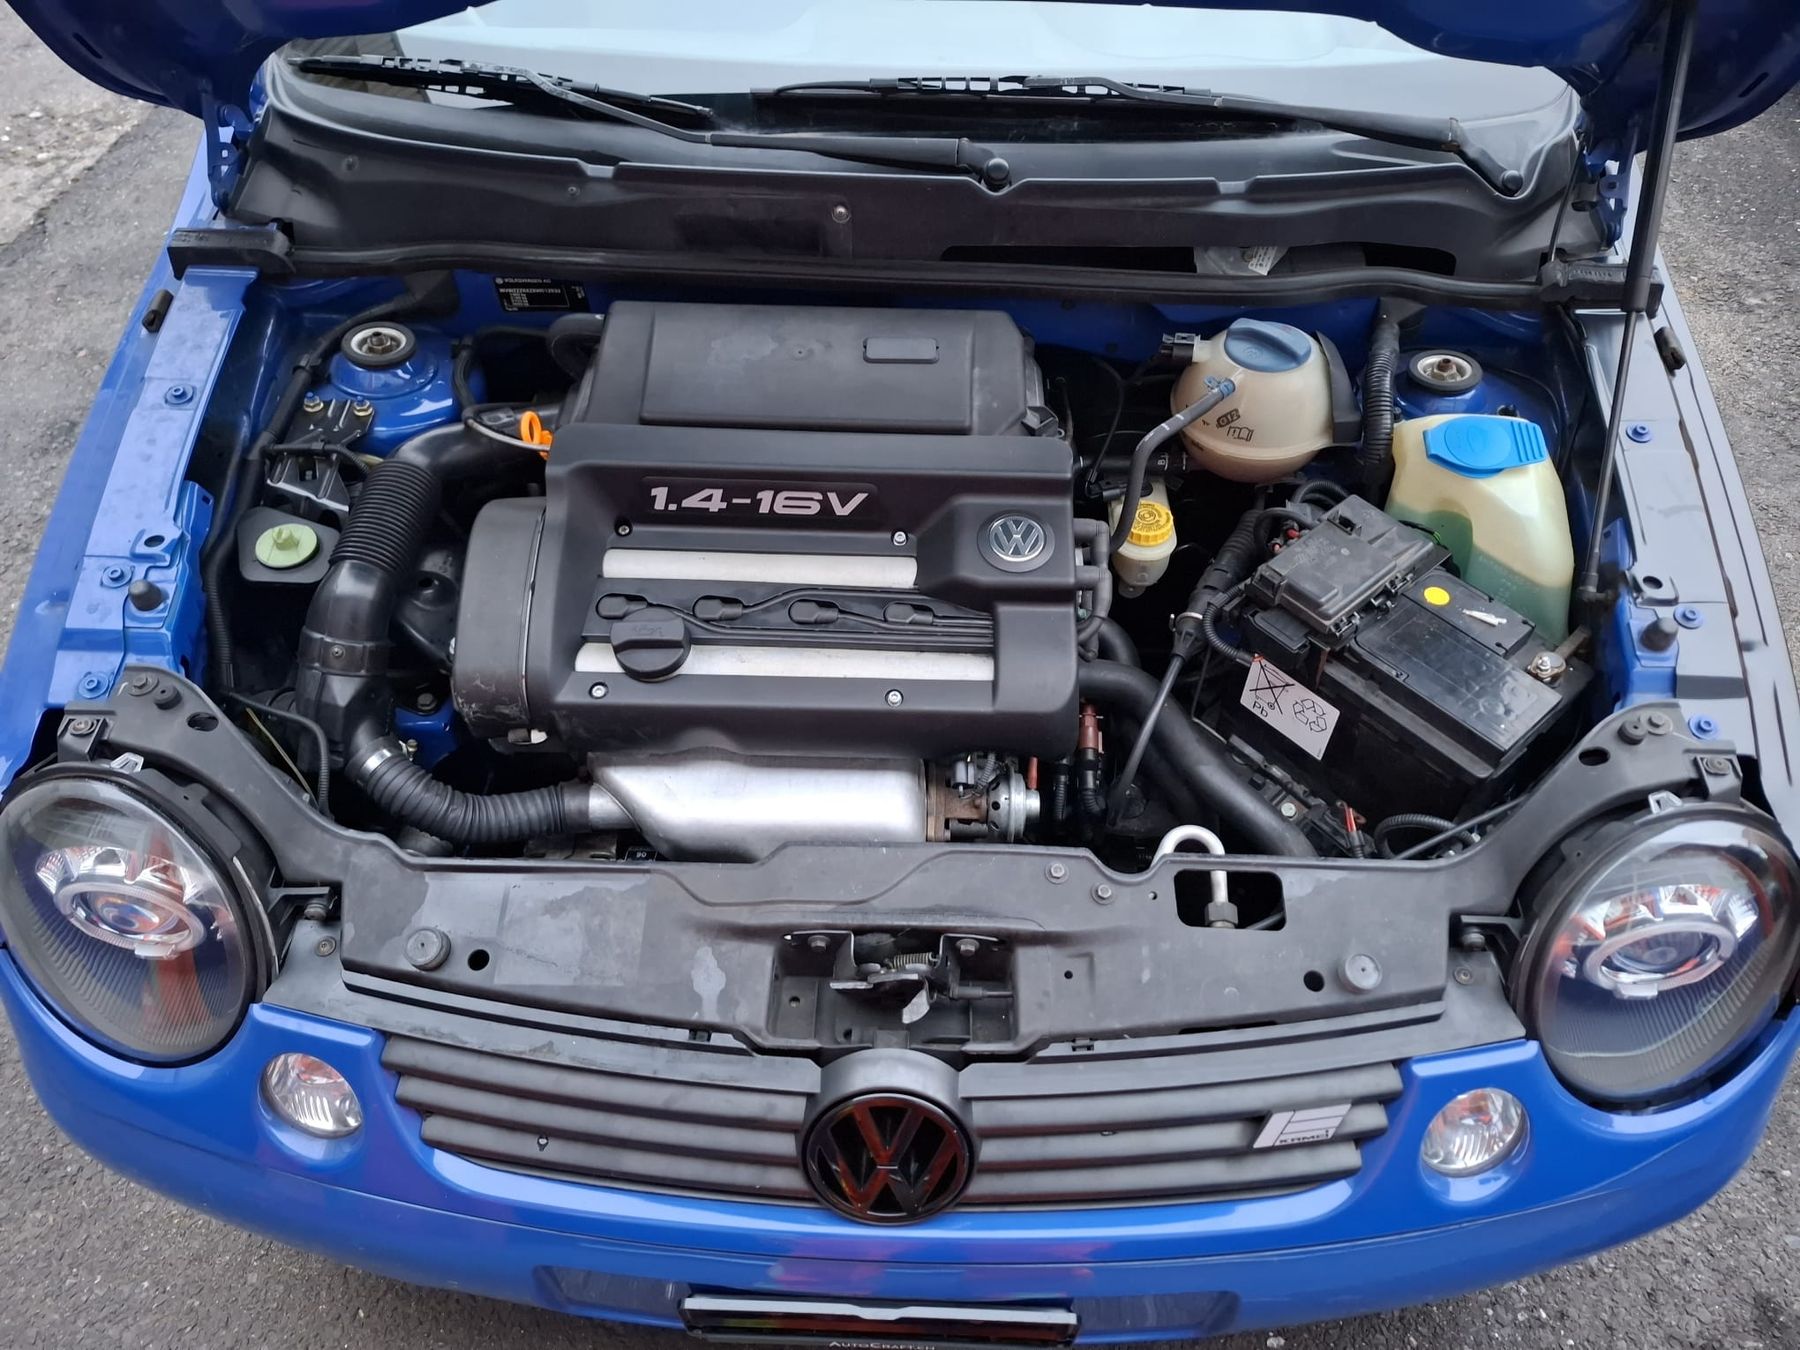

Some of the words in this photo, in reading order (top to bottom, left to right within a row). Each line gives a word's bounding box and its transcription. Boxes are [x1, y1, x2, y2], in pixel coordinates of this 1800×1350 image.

[650, 486, 869, 516] 1.4-16V
[990, 516, 1045, 561] VW
[1252, 700, 1269, 718] Pb
[810, 1096, 966, 1219] VW
